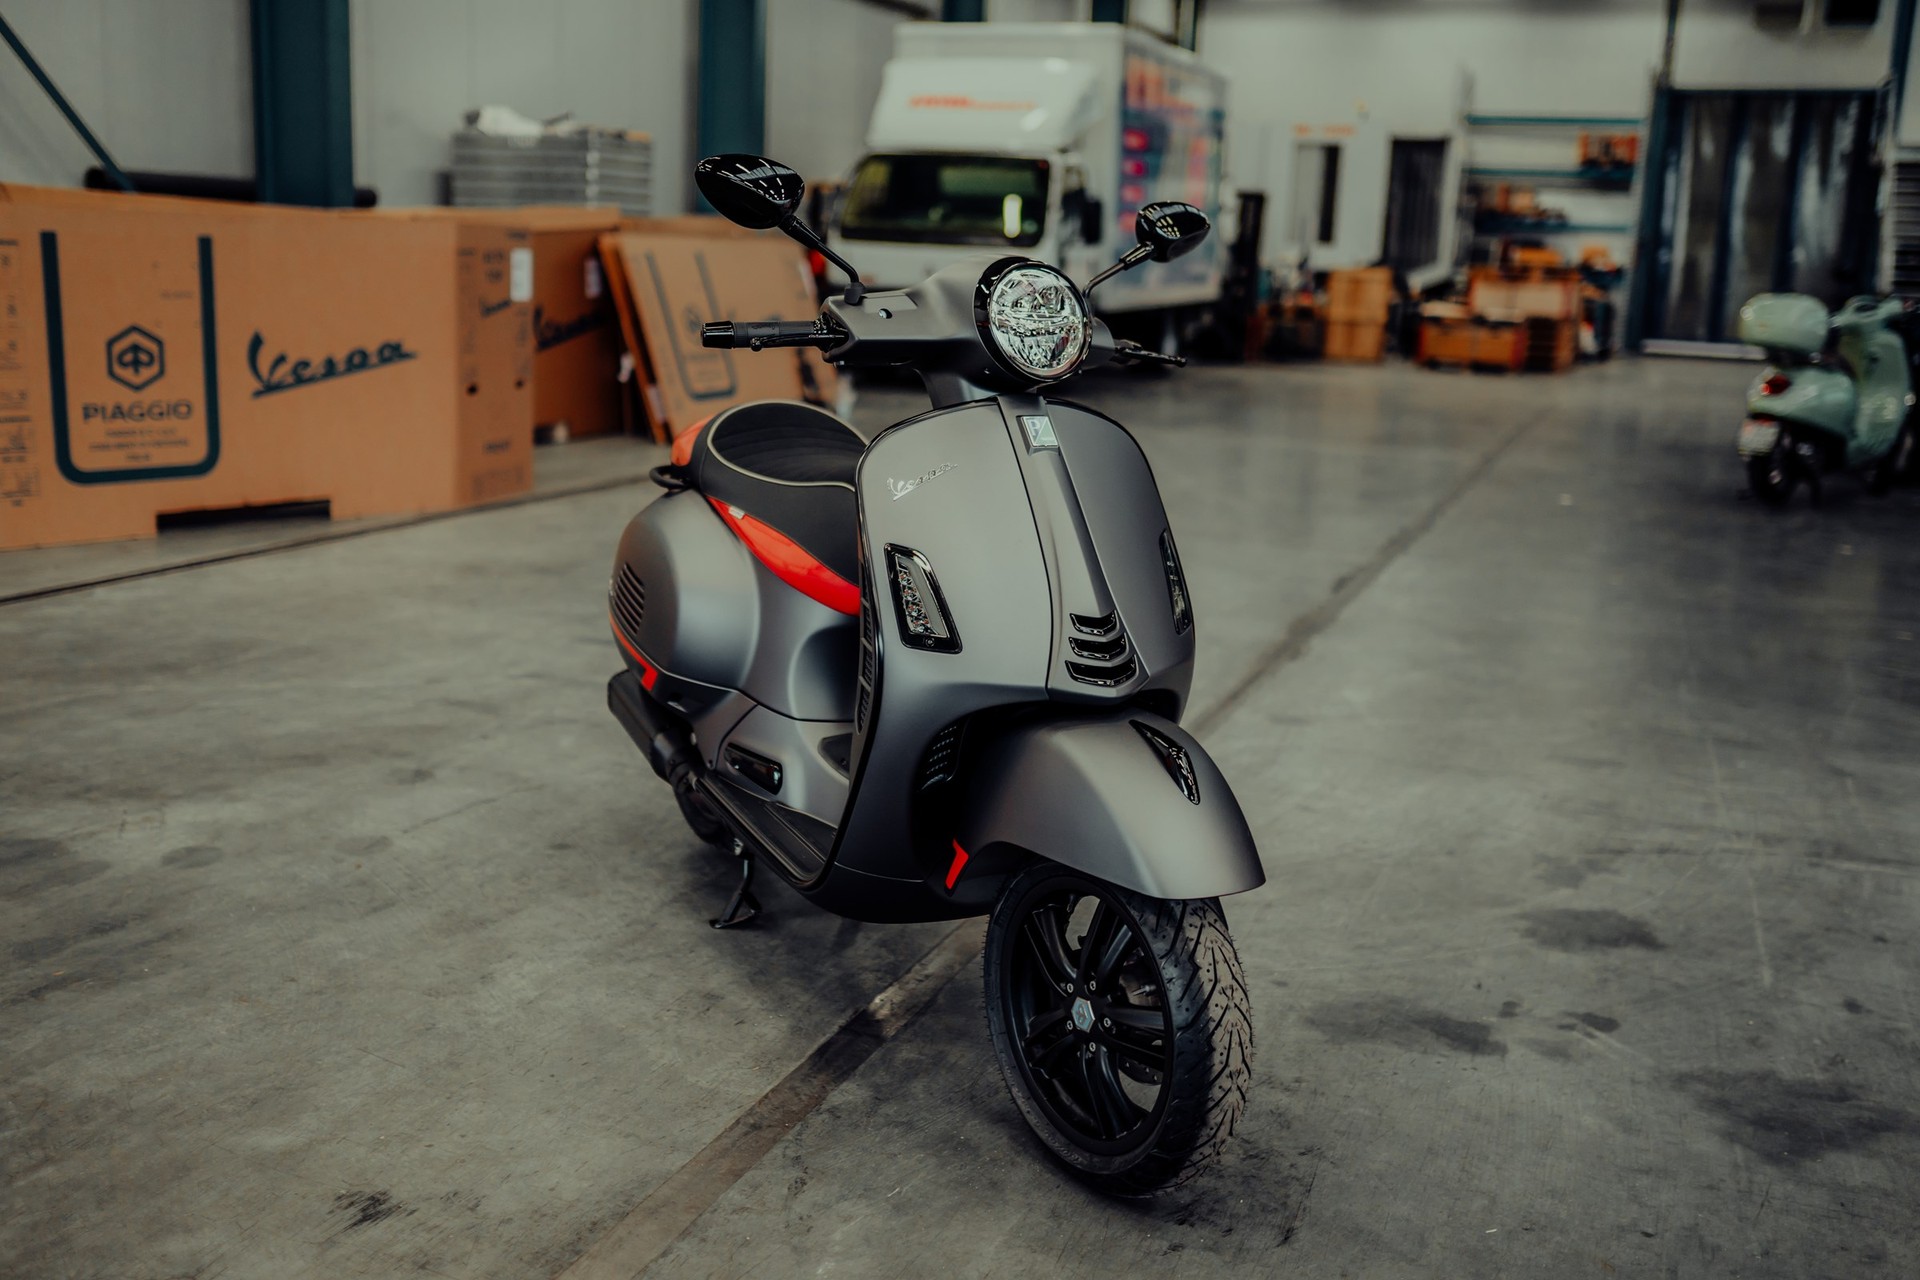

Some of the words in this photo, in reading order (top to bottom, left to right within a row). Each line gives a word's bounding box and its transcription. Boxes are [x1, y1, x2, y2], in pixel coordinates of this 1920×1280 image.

[247, 331, 418, 398] Vespa
[82, 399, 193, 423] PIAGGIO
[886, 462, 959, 501] Vespa
